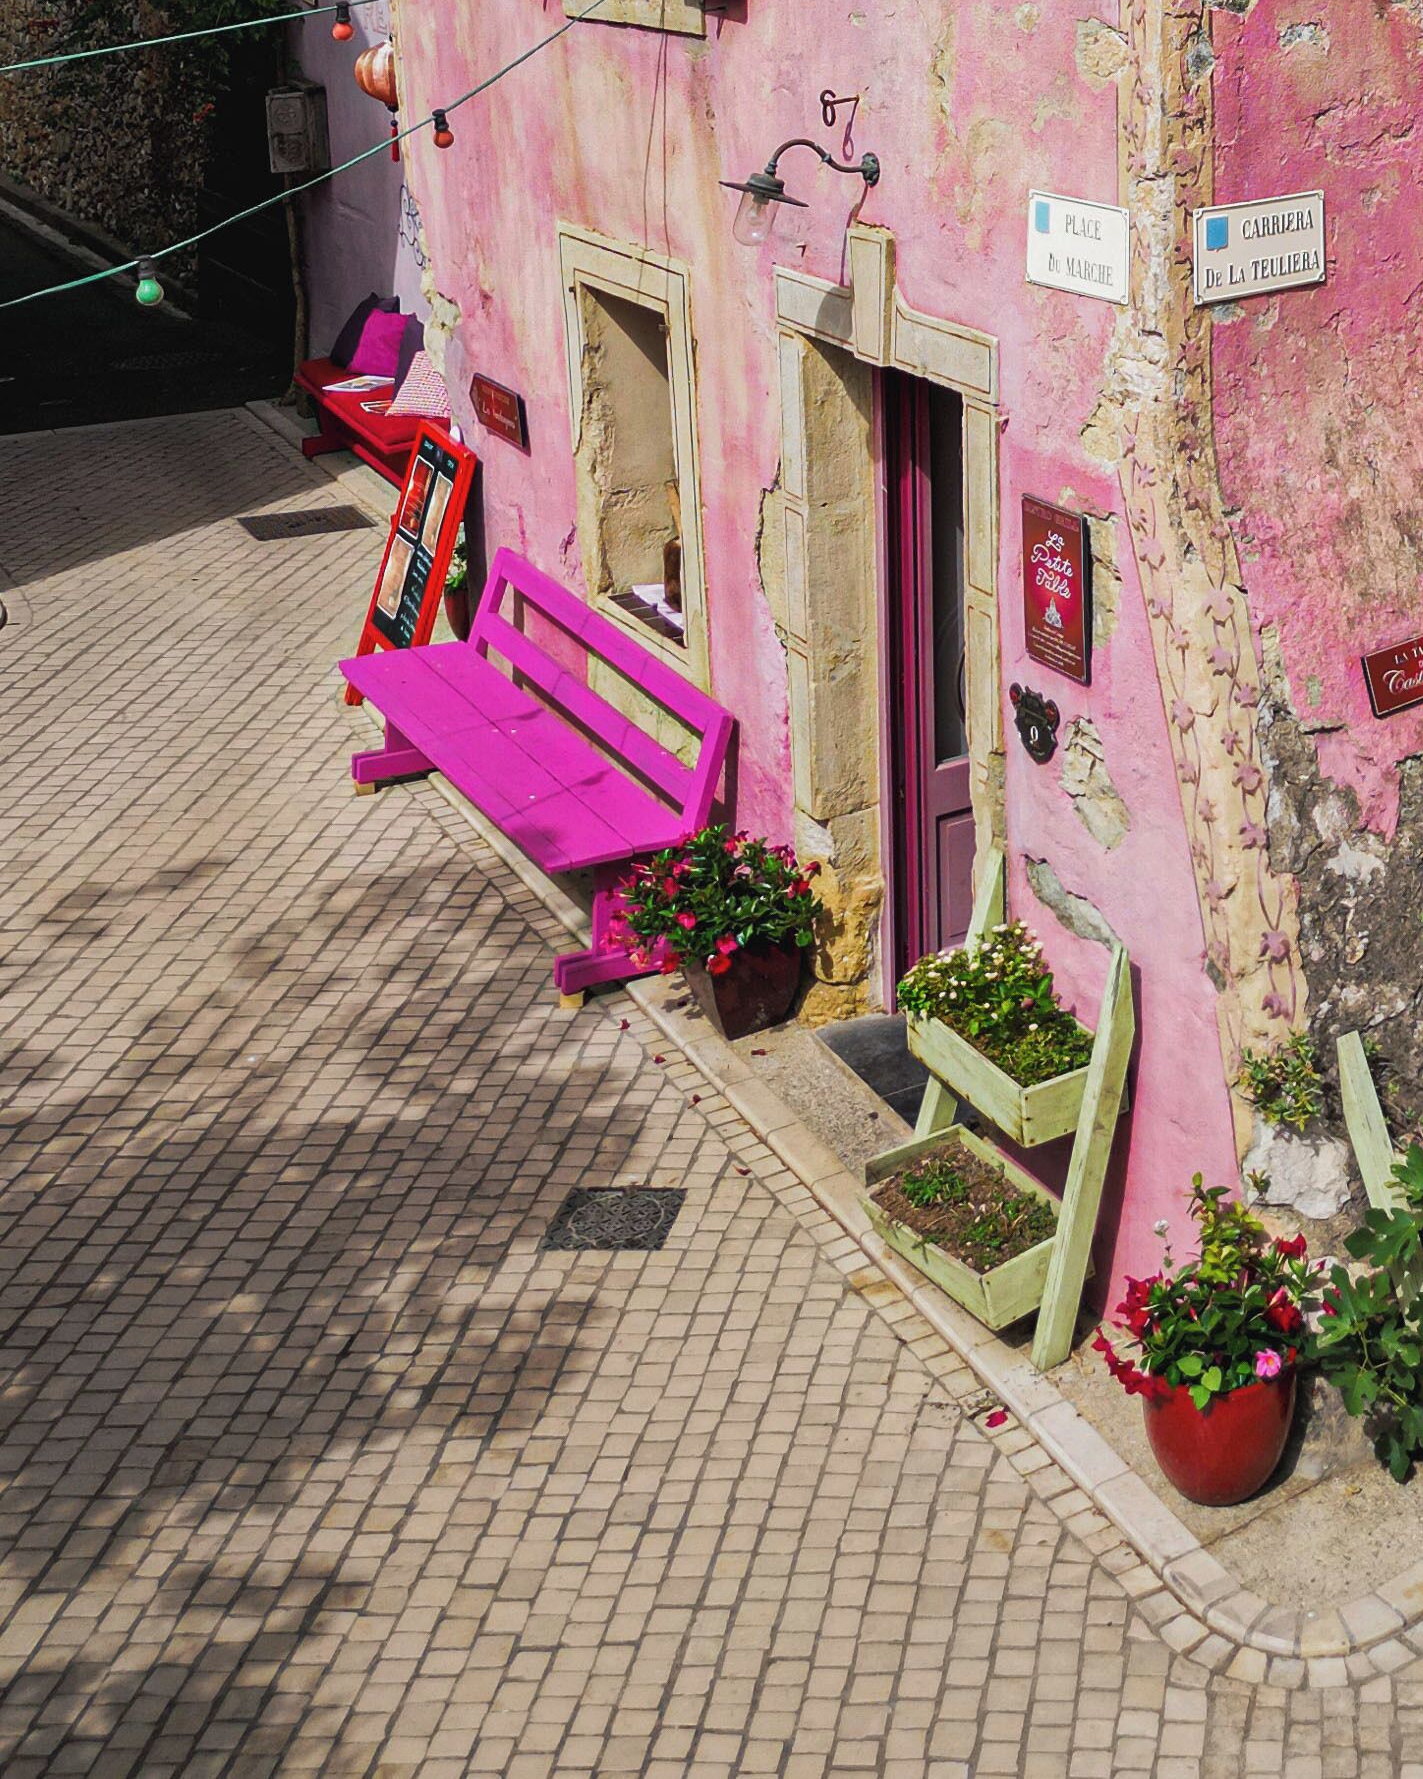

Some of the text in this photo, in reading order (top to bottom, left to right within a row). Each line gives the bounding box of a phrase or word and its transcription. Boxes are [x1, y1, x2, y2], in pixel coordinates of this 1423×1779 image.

[1065, 214, 1102, 241] PLACE
[1242, 209, 1315, 240] CARRIERA
[1066, 255, 1114, 287] MARCHE
[1251, 249, 1320, 281] TEULIERA
[1045, 529, 1065, 552] La
[1030, 543, 1074, 578] Petite
[1035, 567, 1072, 599] Table
